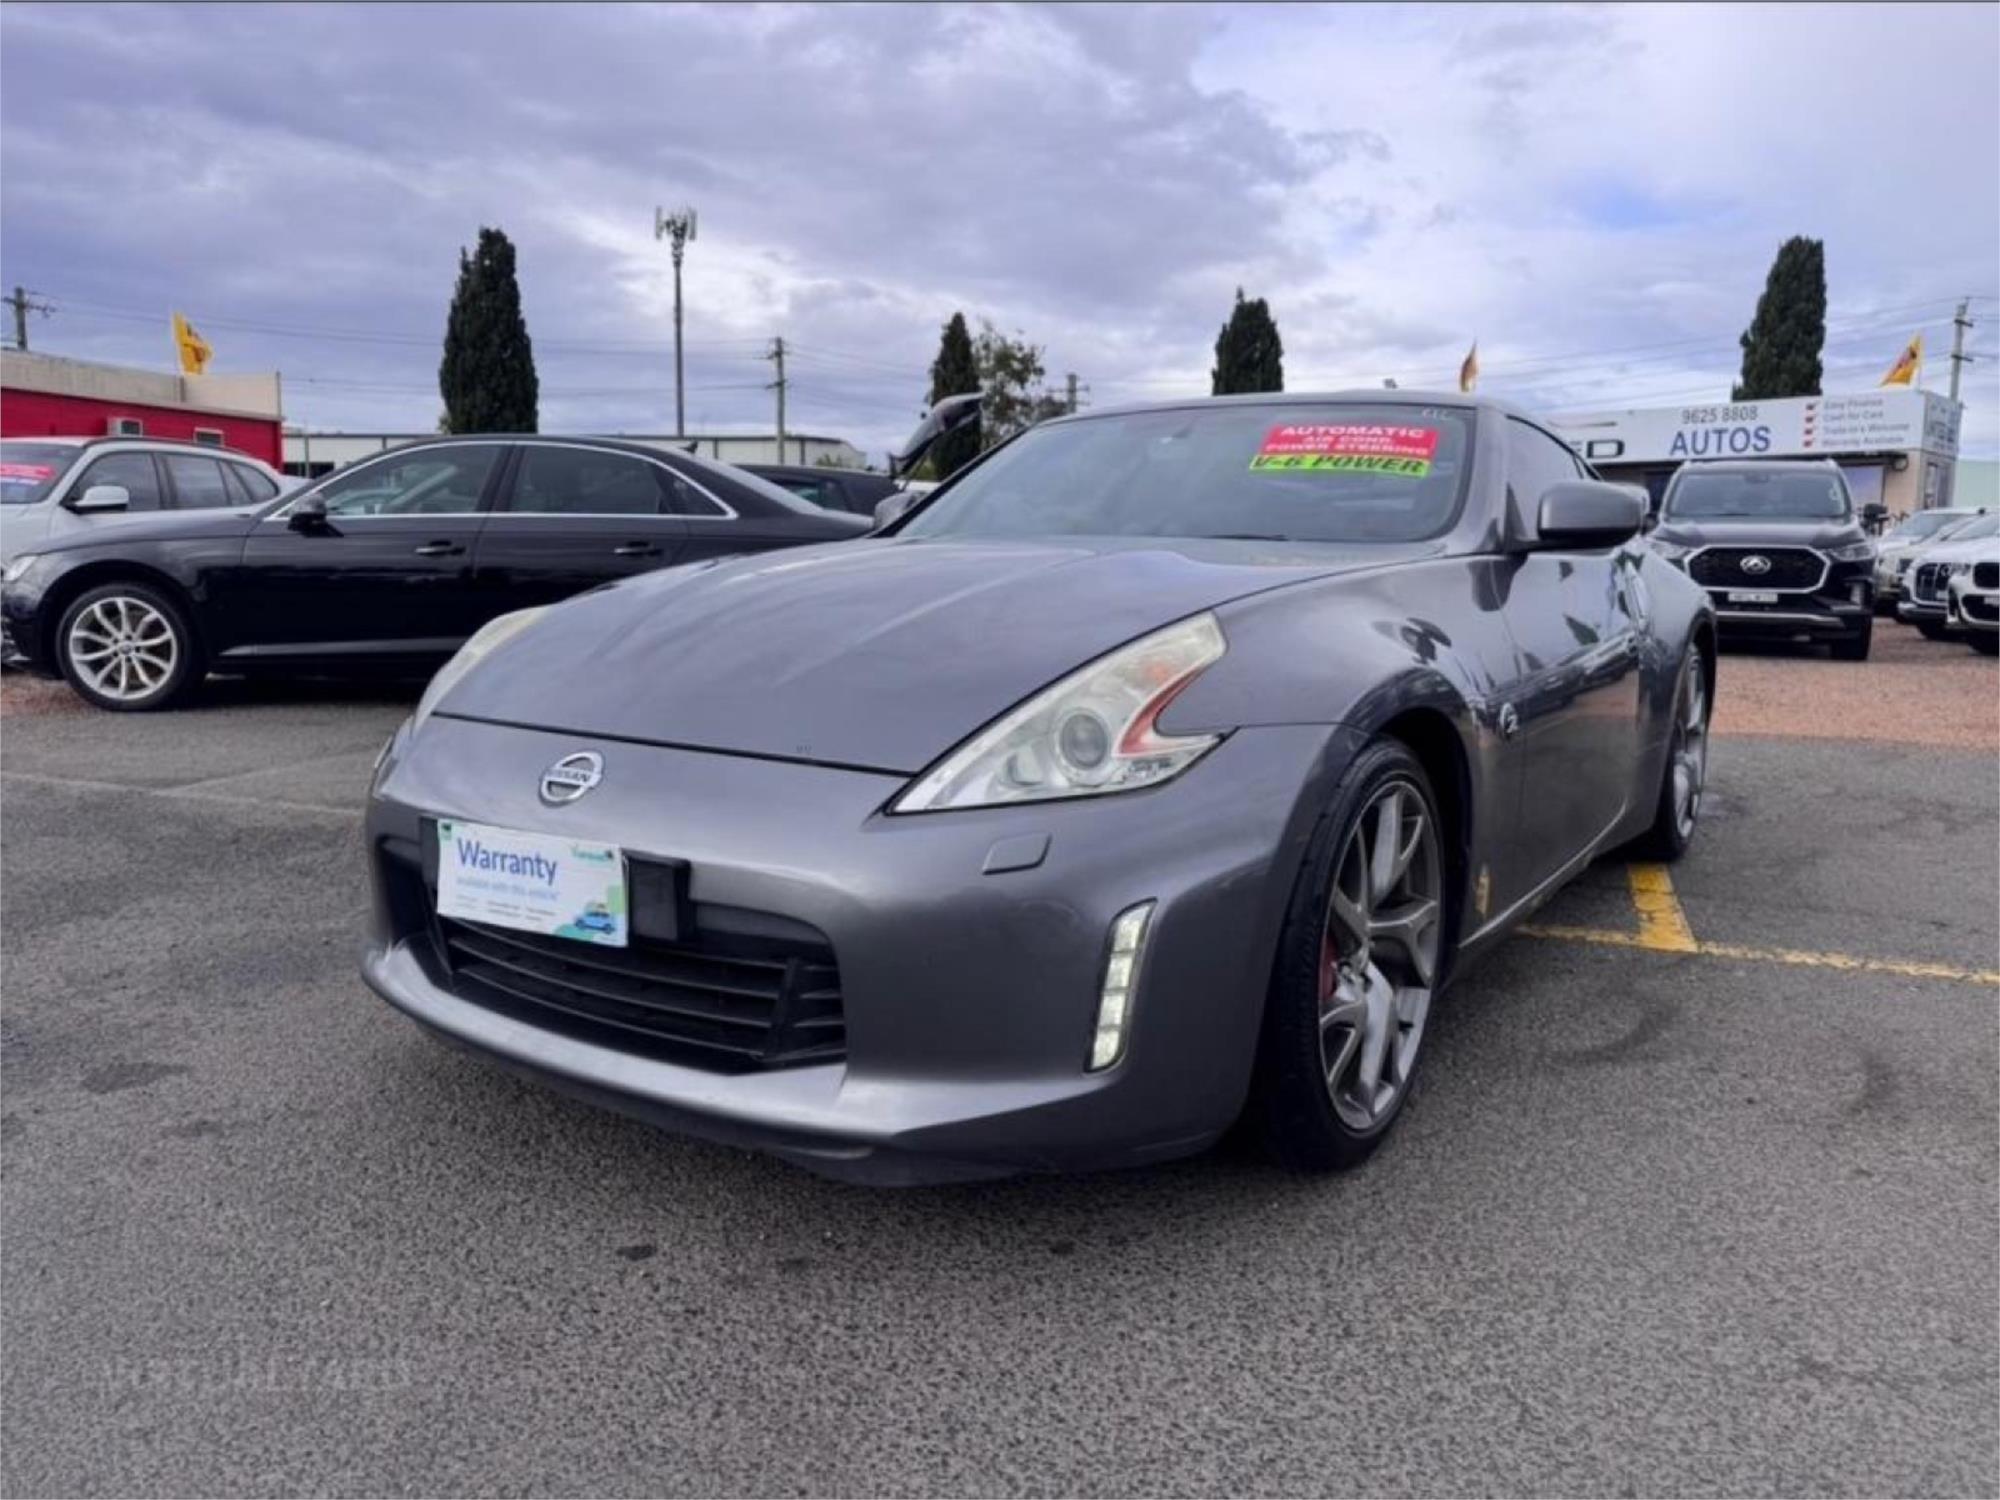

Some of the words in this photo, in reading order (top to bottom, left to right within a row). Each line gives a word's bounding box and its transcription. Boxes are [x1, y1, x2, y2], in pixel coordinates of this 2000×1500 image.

[1682, 408, 1718, 424] 9625
[1722, 406, 1758, 422] 8808
[1281, 426, 1426, 438] AUTOMATIC
[1669, 425, 1771, 457] AUTOS
[1312, 456, 1423, 473] POWER
[457, 837, 557, 886] Warranty
